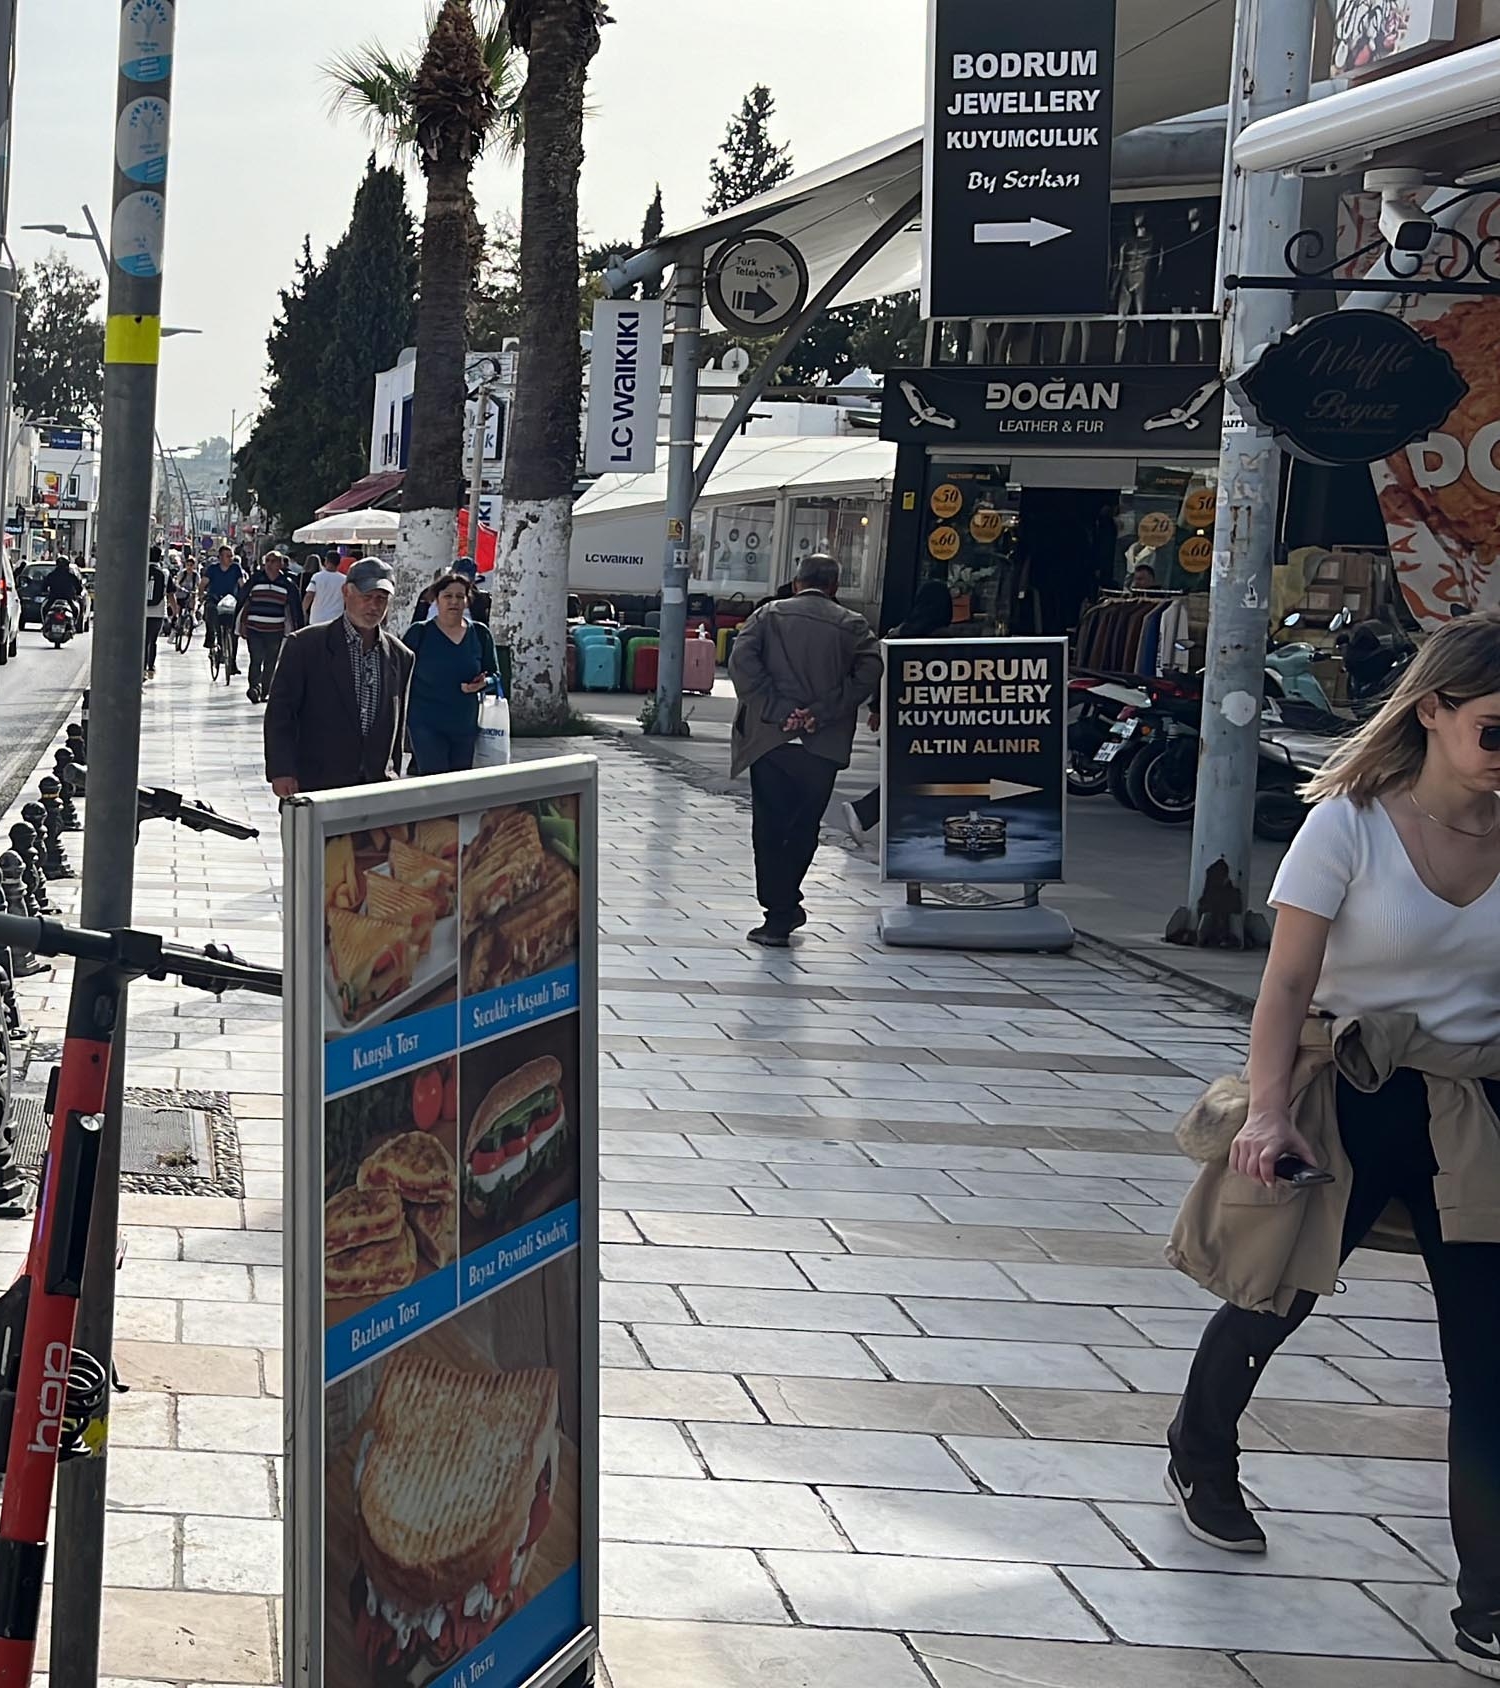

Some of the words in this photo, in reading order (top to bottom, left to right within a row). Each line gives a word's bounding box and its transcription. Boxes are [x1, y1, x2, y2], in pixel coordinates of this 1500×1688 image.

[953, 50, 1098, 79] BODRUM
[947, 90, 1100, 115] JEWELLERY
[946, 128, 1098, 149] KUYUMCULUK
[967, 171, 997, 194] By
[1002, 168, 1080, 189] Serkan
[735, 266, 776, 279] Telekom
[736, 256, 757, 267] Türk
[1297, 336, 1413, 389] Waffle
[985, 377, 1120, 410] DOĞAN
[999, 420, 1059, 433] LEATHER
[1062, 420, 1073, 433] &
[1076, 420, 1104, 433] FUR
[903, 658, 1048, 682] BODRUM
[898, 684, 1052, 705] JEWELLERY
[898, 708, 1051, 727] KUYUMCULUK
[909, 739, 967, 755] ALTIN
[972, 738, 1041, 754] ALINIR
[551, 981, 570, 1001] Tost
[396, 1032, 419, 1055] Tost
[397, 1301, 420, 1325] Tost
[27, 1341, 69, 1454] hop
